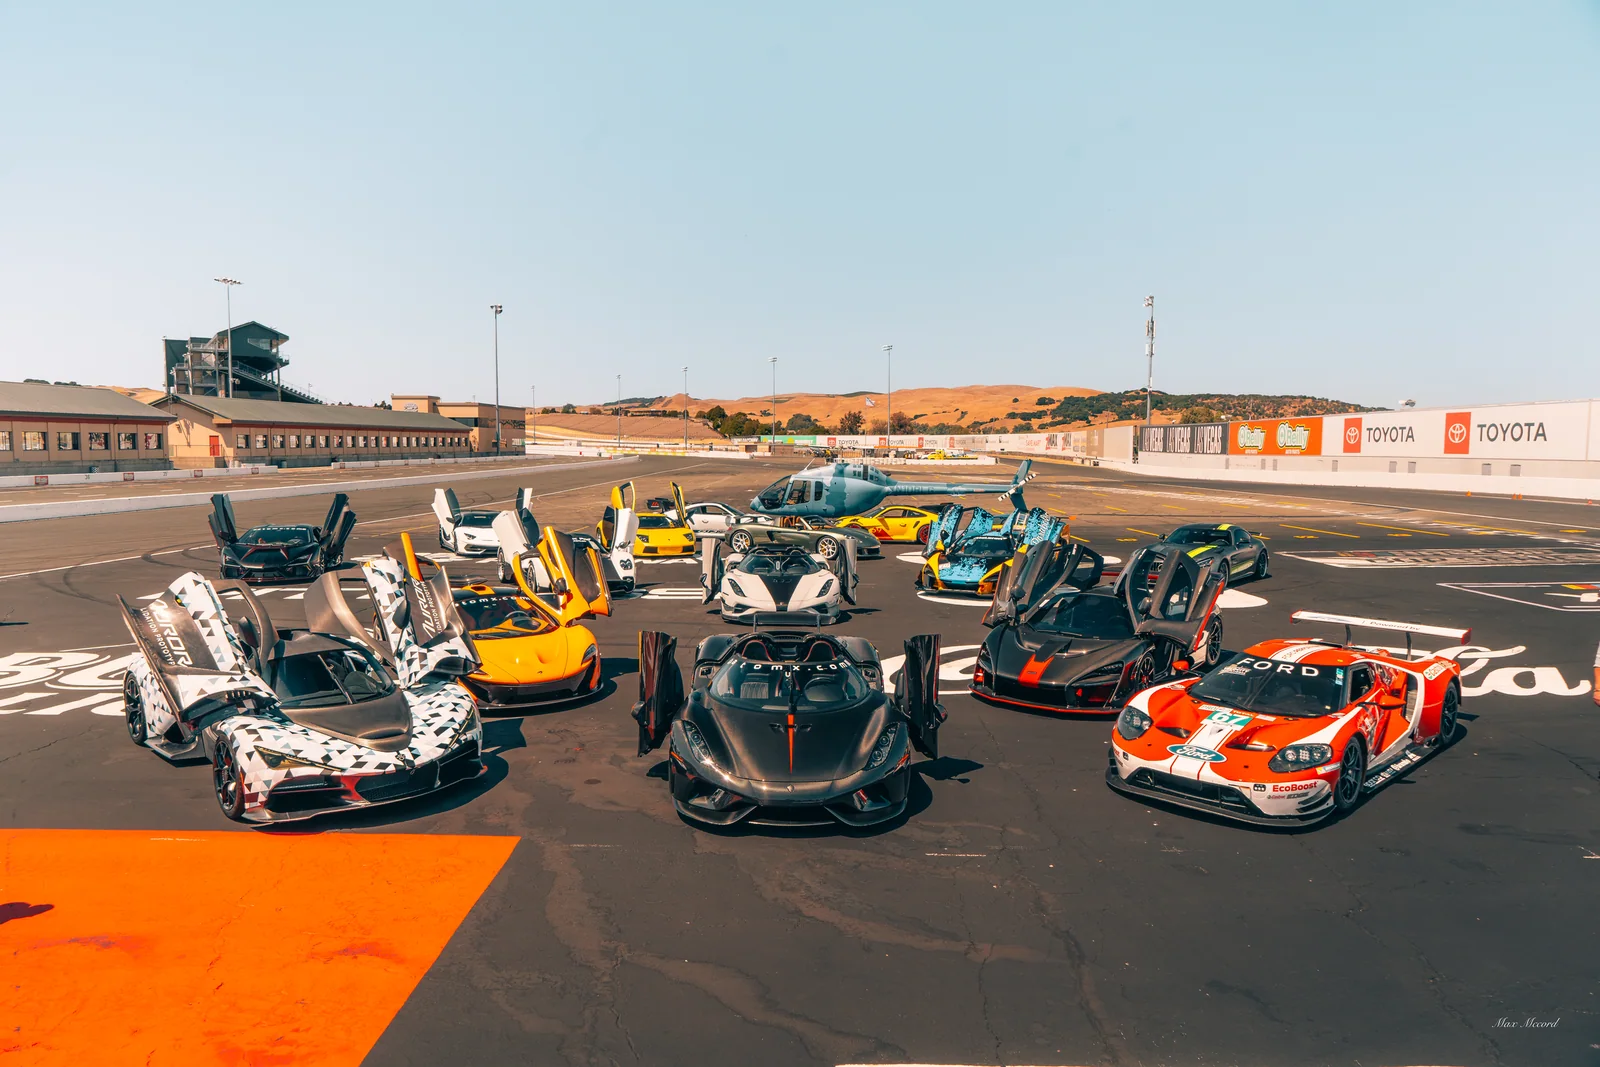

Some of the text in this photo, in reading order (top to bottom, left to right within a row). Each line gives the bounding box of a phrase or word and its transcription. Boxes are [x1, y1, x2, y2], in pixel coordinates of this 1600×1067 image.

[1175, 427, 1191, 453] VEGAS
[1204, 425, 1222, 454] VEGAS
[1238, 425, 1266, 450] O'Reilly
[1277, 422, 1310, 450] O'Reilly
[1366, 426, 1415, 442] TOYOTA
[1476, 422, 1548, 442] TOYOTA
[1369, 621, 1408, 630] Powered
[140, 608, 176, 666] LIDATION PROTOTYP
[1236, 657, 1320, 677] FORD
[1211, 710, 1250, 726] 67
[1176, 745, 1216, 760] Ford
[1272, 781, 1318, 792] EcoBoost
